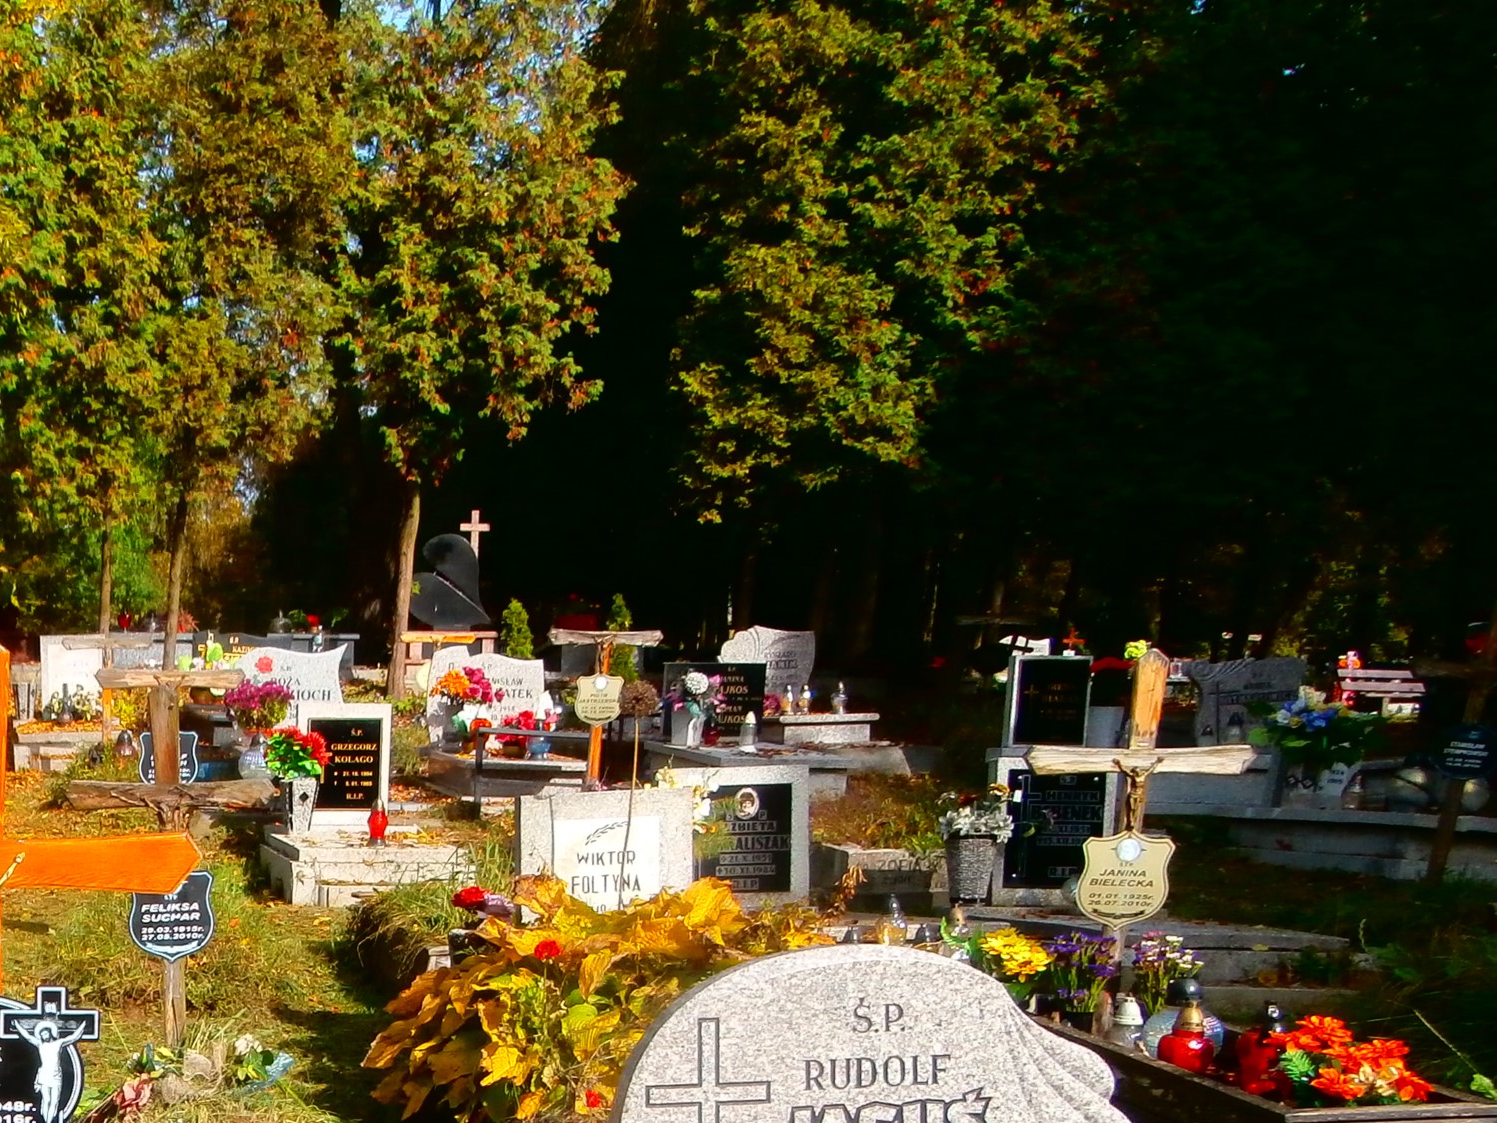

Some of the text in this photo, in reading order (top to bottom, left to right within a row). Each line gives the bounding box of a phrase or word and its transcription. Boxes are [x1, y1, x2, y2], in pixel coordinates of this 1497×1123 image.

[331, 743, 377, 751] GRZEGORZ
[335, 755, 374, 763] KOLAGO
[577, 851, 636, 866] WIKTOR
[1099, 869, 1146, 877] JANINA
[571, 873, 641, 894] FOLTYNA
[1089, 878, 1153, 887] BIELECKA
[141, 902, 200, 913] FELIKSA
[142, 912, 201, 923] SUCHAR
[803, 1055, 951, 1091] RUDOLF
